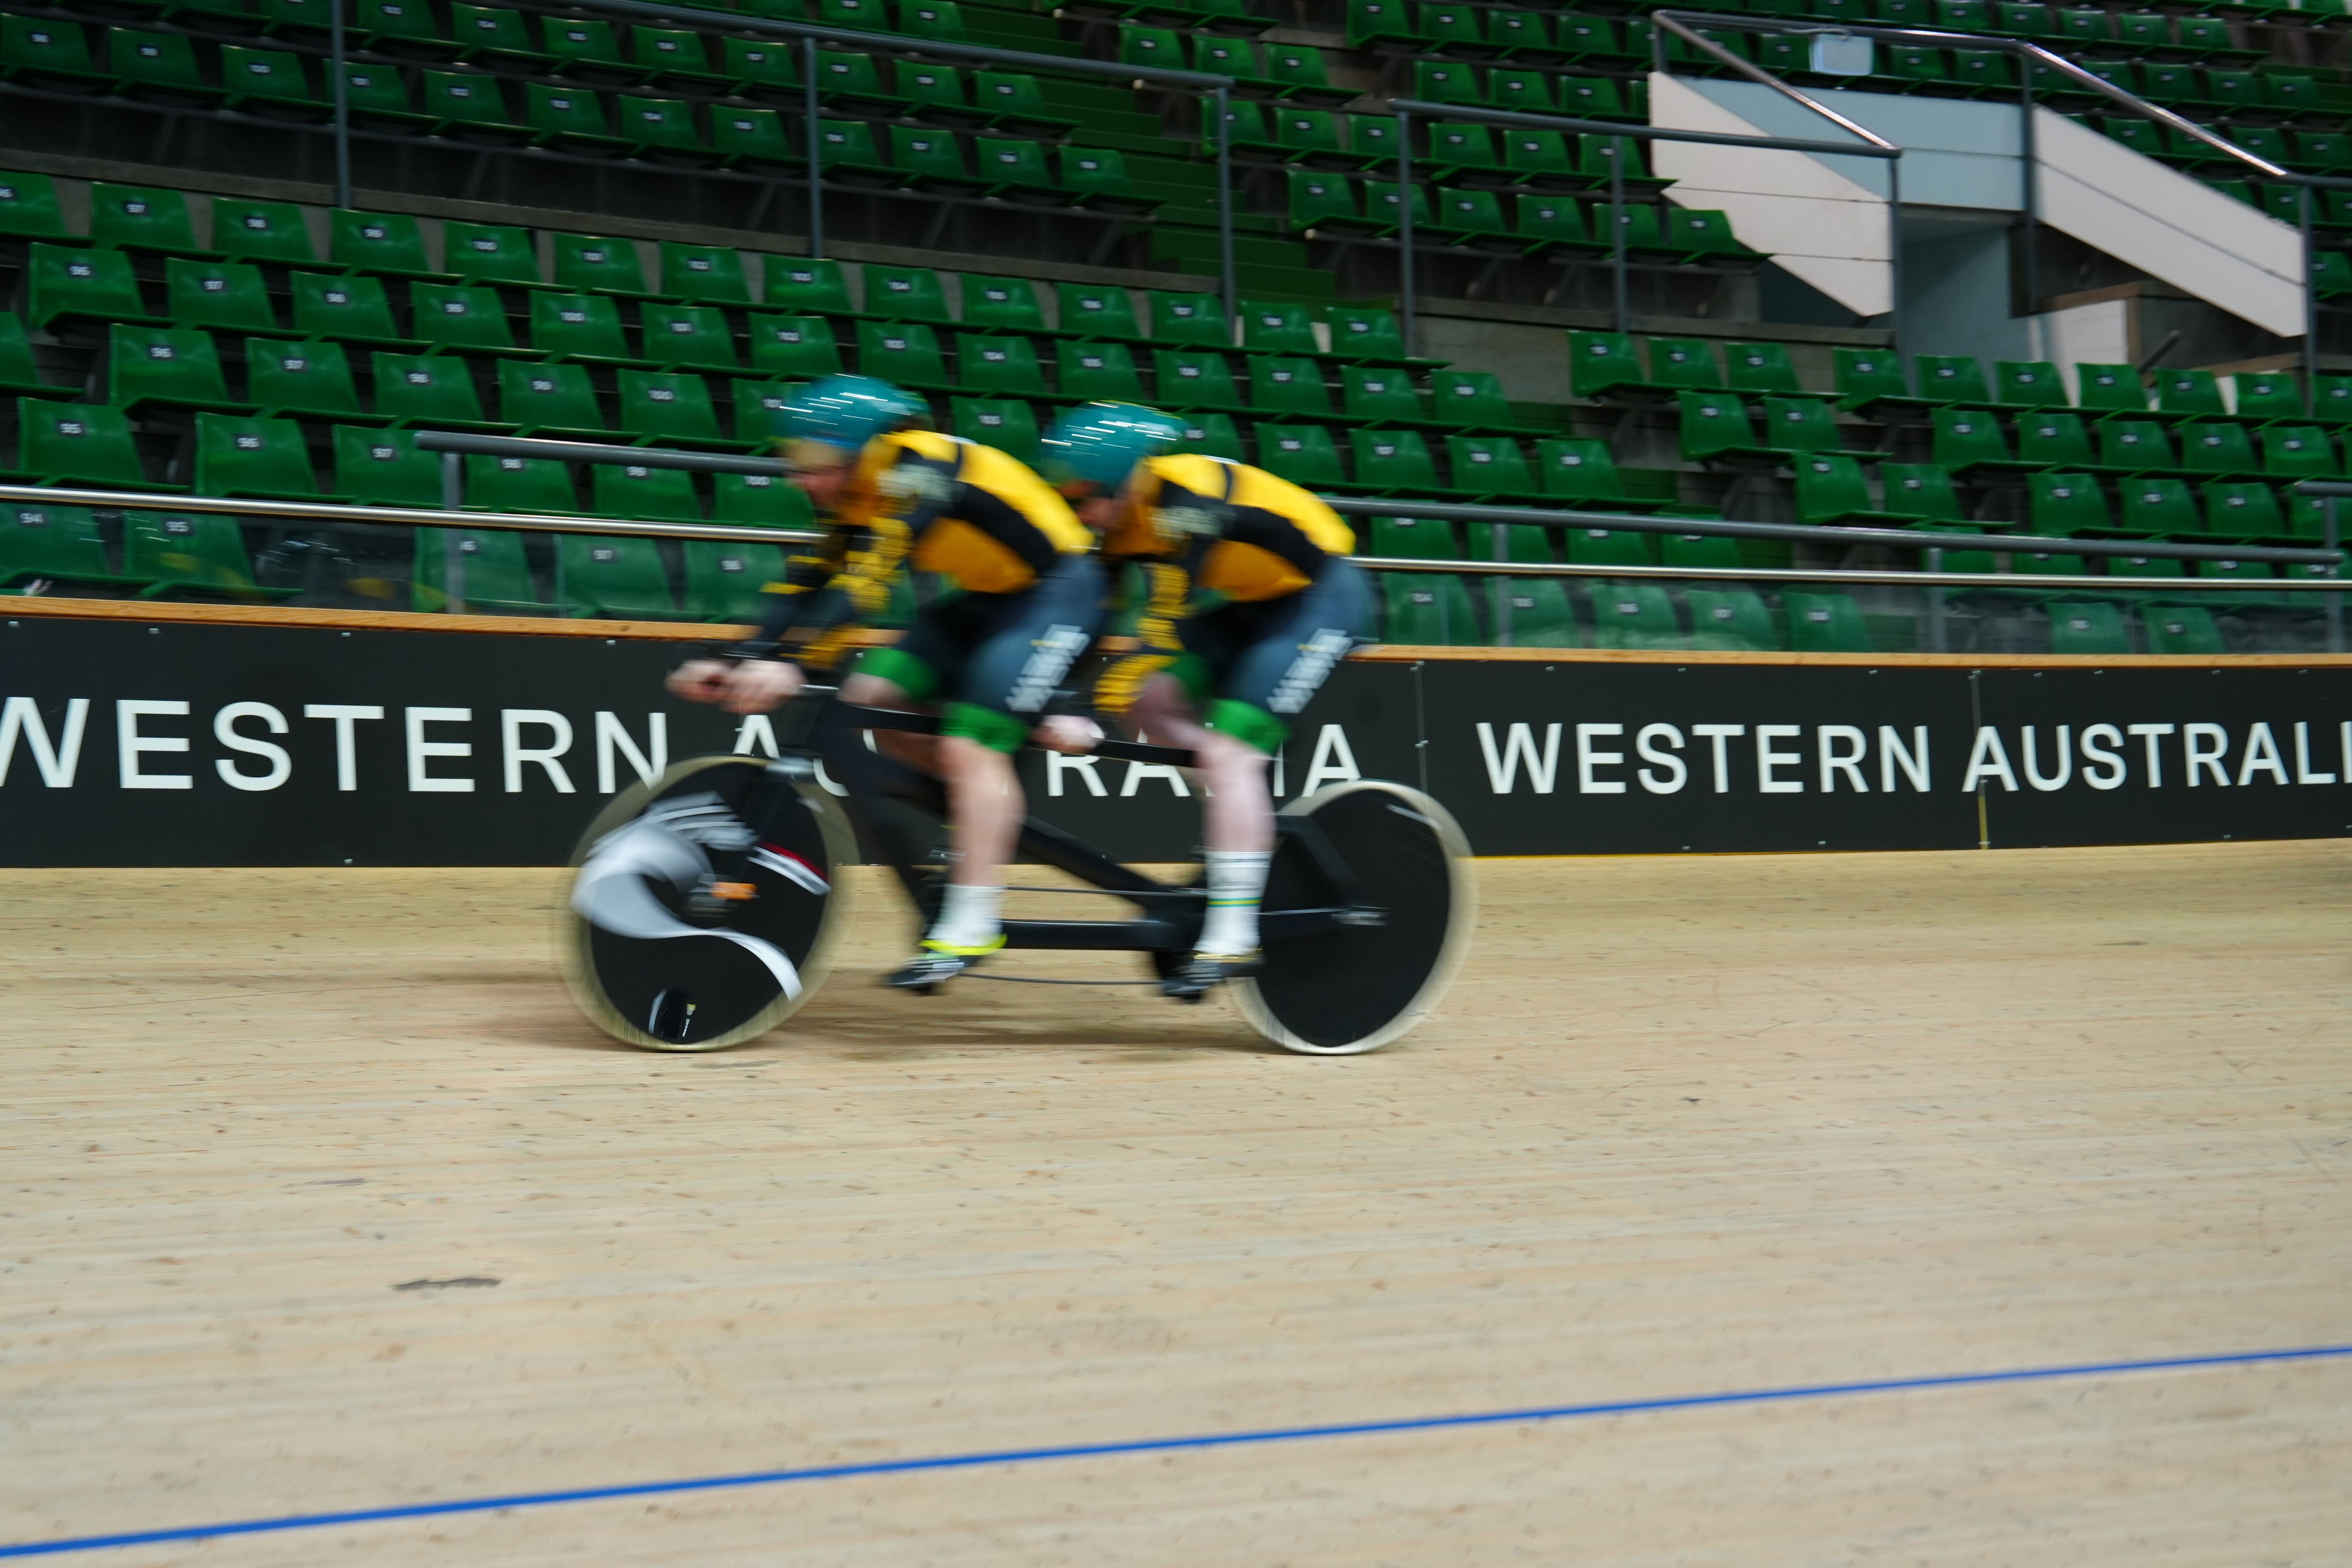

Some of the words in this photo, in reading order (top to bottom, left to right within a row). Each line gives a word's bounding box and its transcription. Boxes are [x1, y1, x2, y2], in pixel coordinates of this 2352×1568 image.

[0, 697, 668, 794] WESTERN
[1477, 722, 1931, 794] WESTERN
[1961, 721, 2352, 793] AUSTRALI
